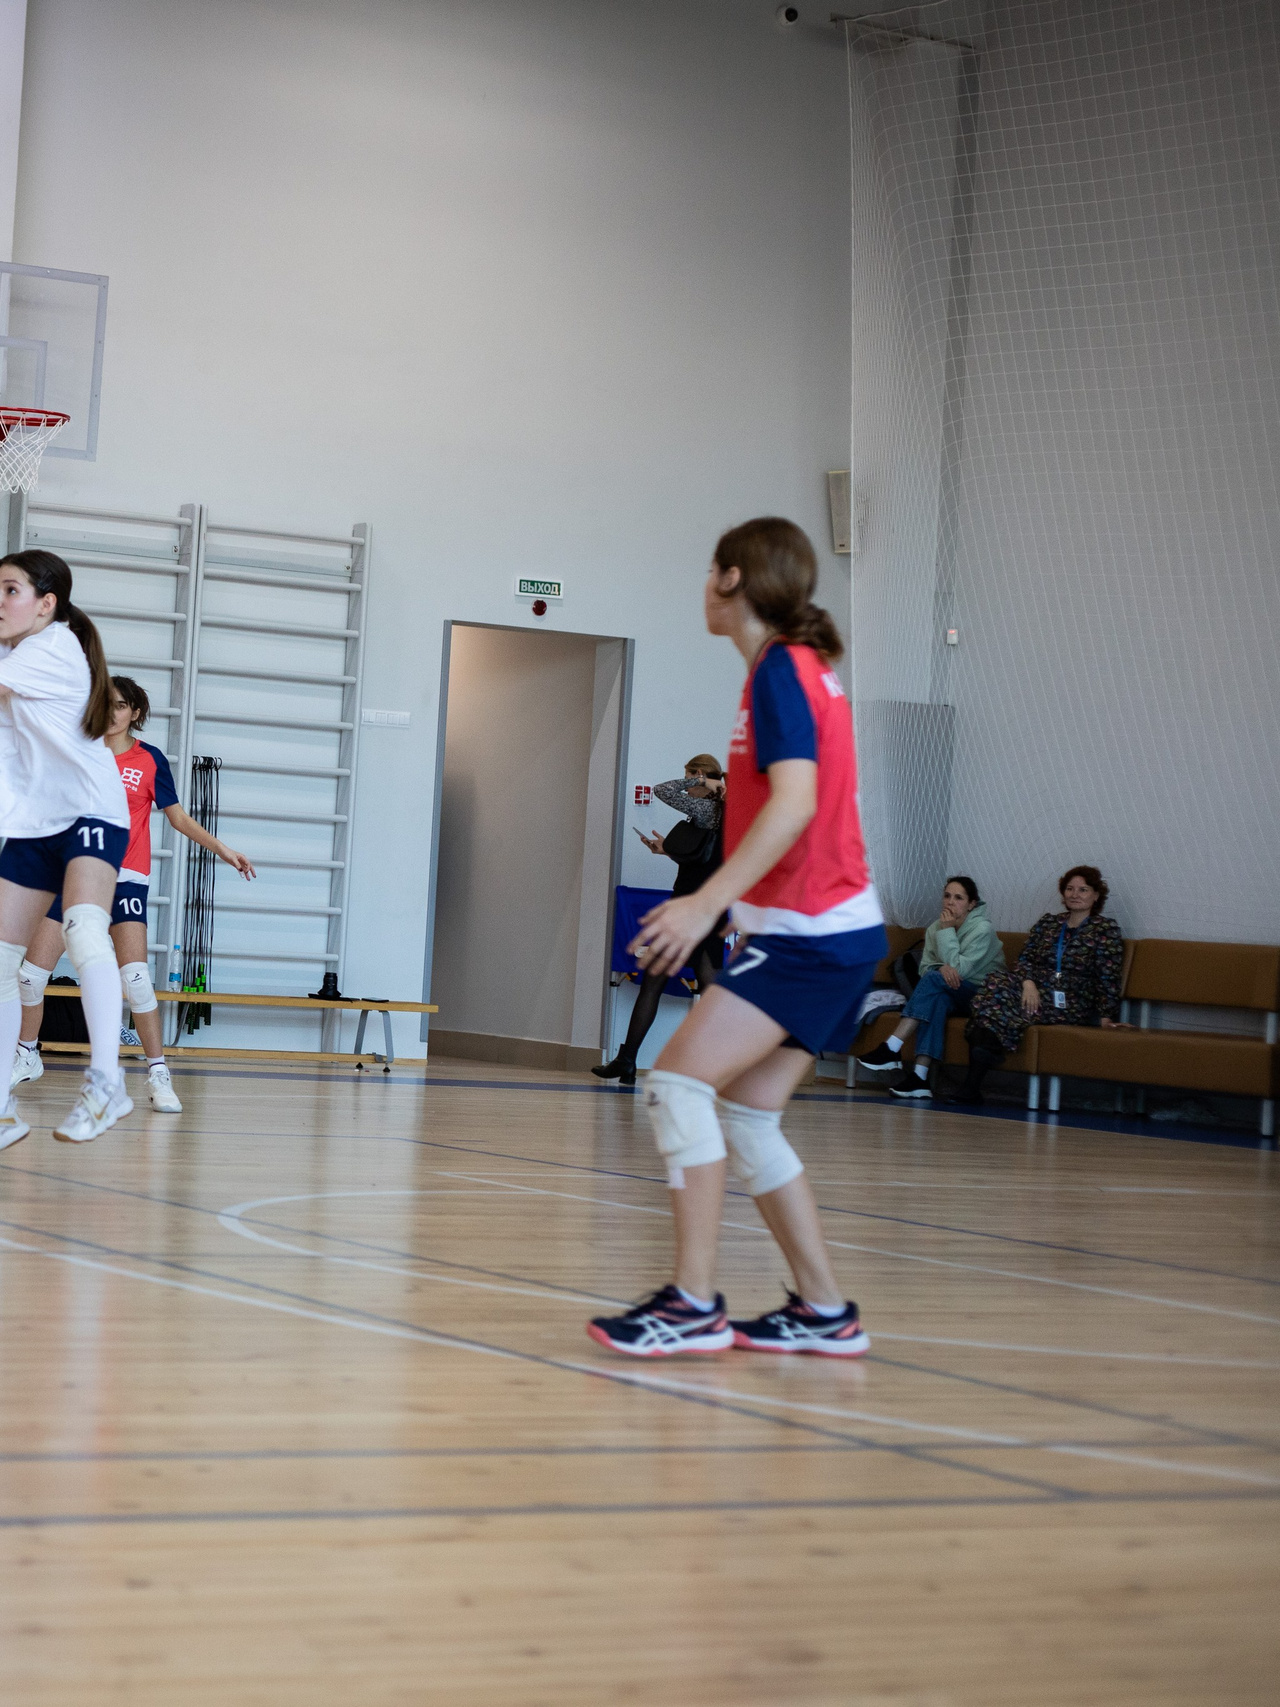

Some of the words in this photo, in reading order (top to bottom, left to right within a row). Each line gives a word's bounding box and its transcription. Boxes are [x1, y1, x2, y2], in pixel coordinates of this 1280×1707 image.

[520, 580, 560, 596] ВЫХОД
[77, 826, 105, 851] 11
[118, 897, 142, 915] 10
[729, 945, 769, 977] 7
